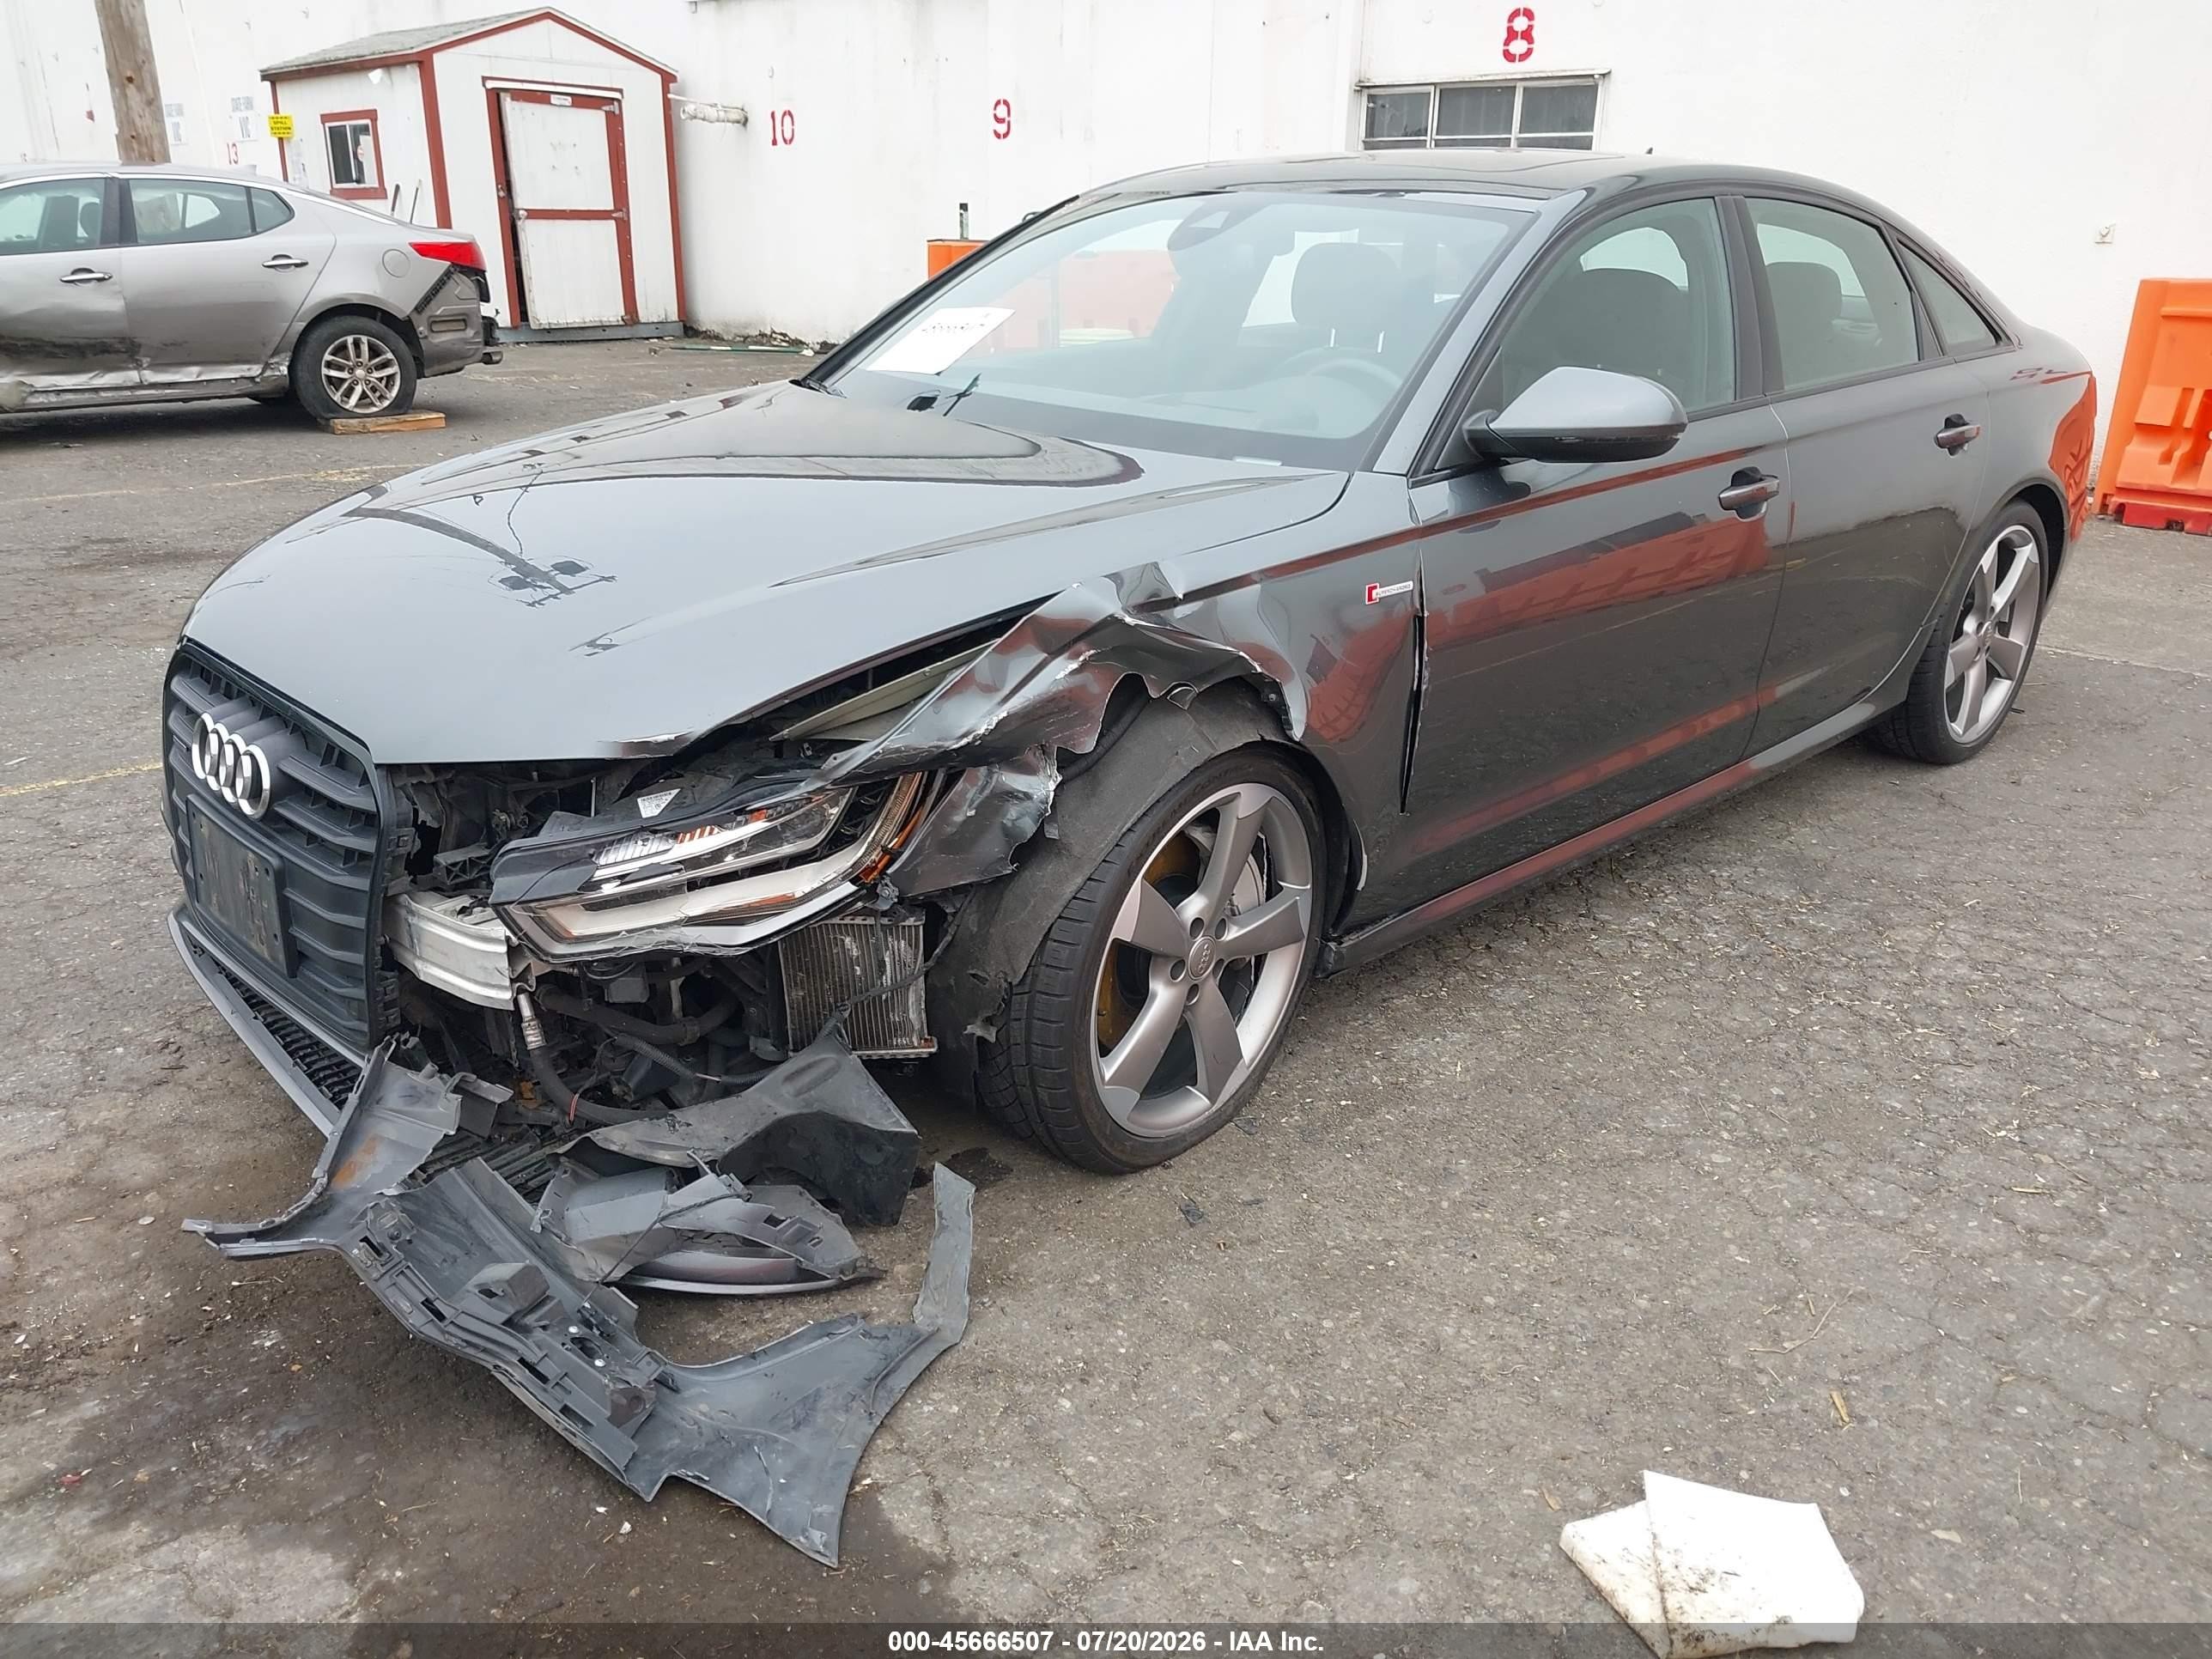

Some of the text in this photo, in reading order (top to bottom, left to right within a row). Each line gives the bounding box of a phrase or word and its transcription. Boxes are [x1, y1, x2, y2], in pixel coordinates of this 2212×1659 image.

[1502, 7, 1534, 63] 8
[770, 109, 794, 146] 10
[993, 99, 1011, 139] 9
[226, 143, 240, 166] 13
